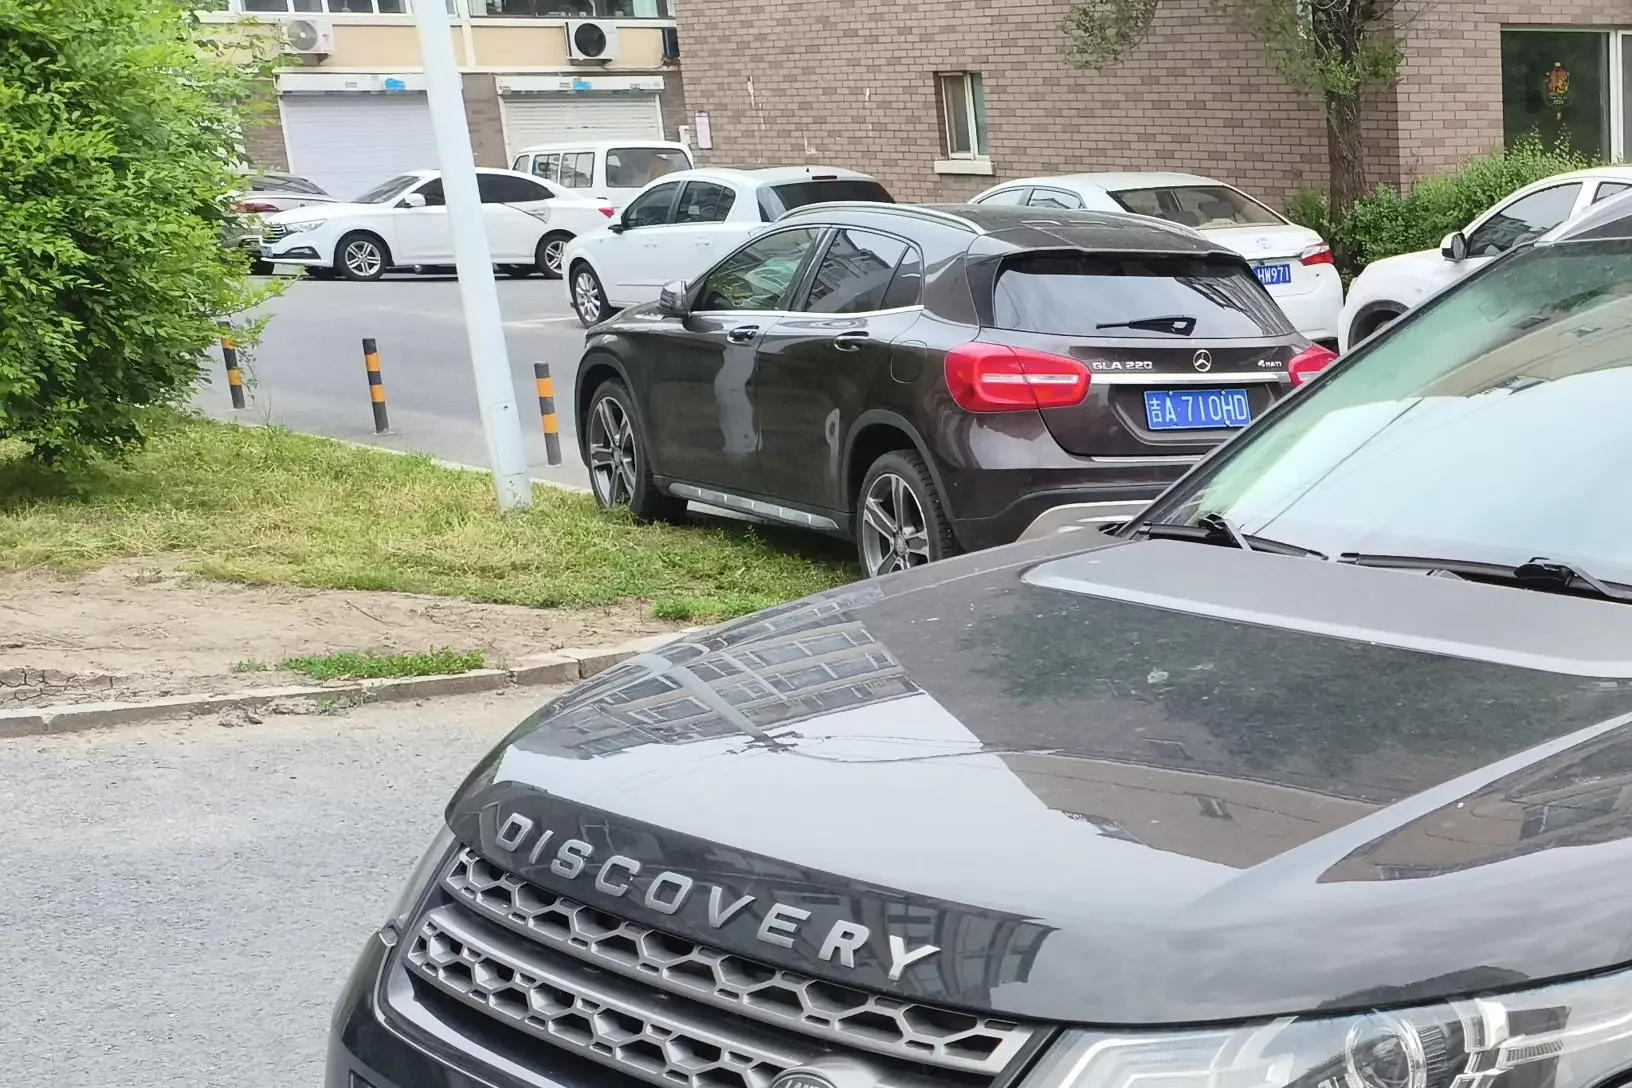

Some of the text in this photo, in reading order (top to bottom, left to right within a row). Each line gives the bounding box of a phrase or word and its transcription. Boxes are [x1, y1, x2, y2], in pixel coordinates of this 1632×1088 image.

[1257, 266, 1290, 283] HW971
[1092, 361, 1153, 370] GLA 220
[496, 812, 942, 981] DISCOVERY
